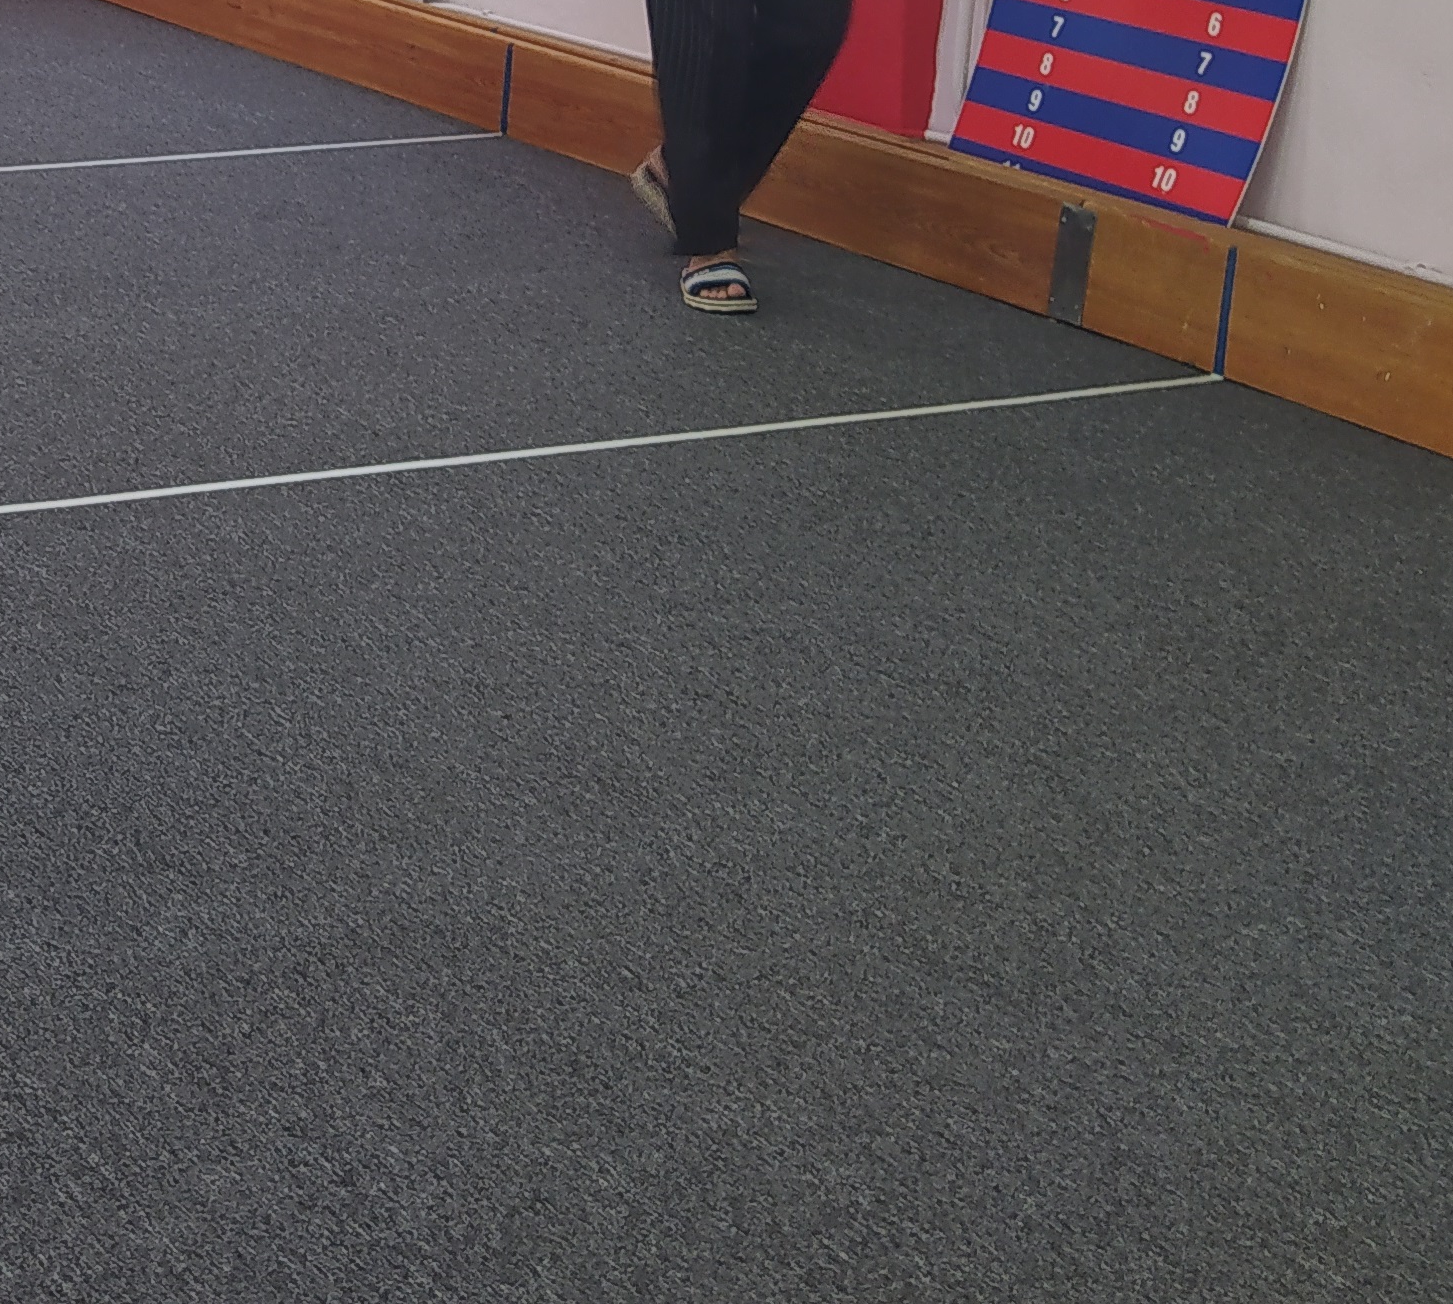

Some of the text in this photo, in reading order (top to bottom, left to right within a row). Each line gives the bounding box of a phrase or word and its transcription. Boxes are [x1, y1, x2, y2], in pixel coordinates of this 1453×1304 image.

[1051, 15, 1065, 38] 7
[1207, 12, 1223, 37] 6
[1039, 53, 1054, 76] 8
[1197, 51, 1213, 75] 7
[1028, 89, 1043, 112] 9
[1183, 90, 1199, 114] 8
[1012, 124, 1035, 149] 10
[1170, 128, 1186, 153] 9
[1151, 165, 1177, 192] 10
